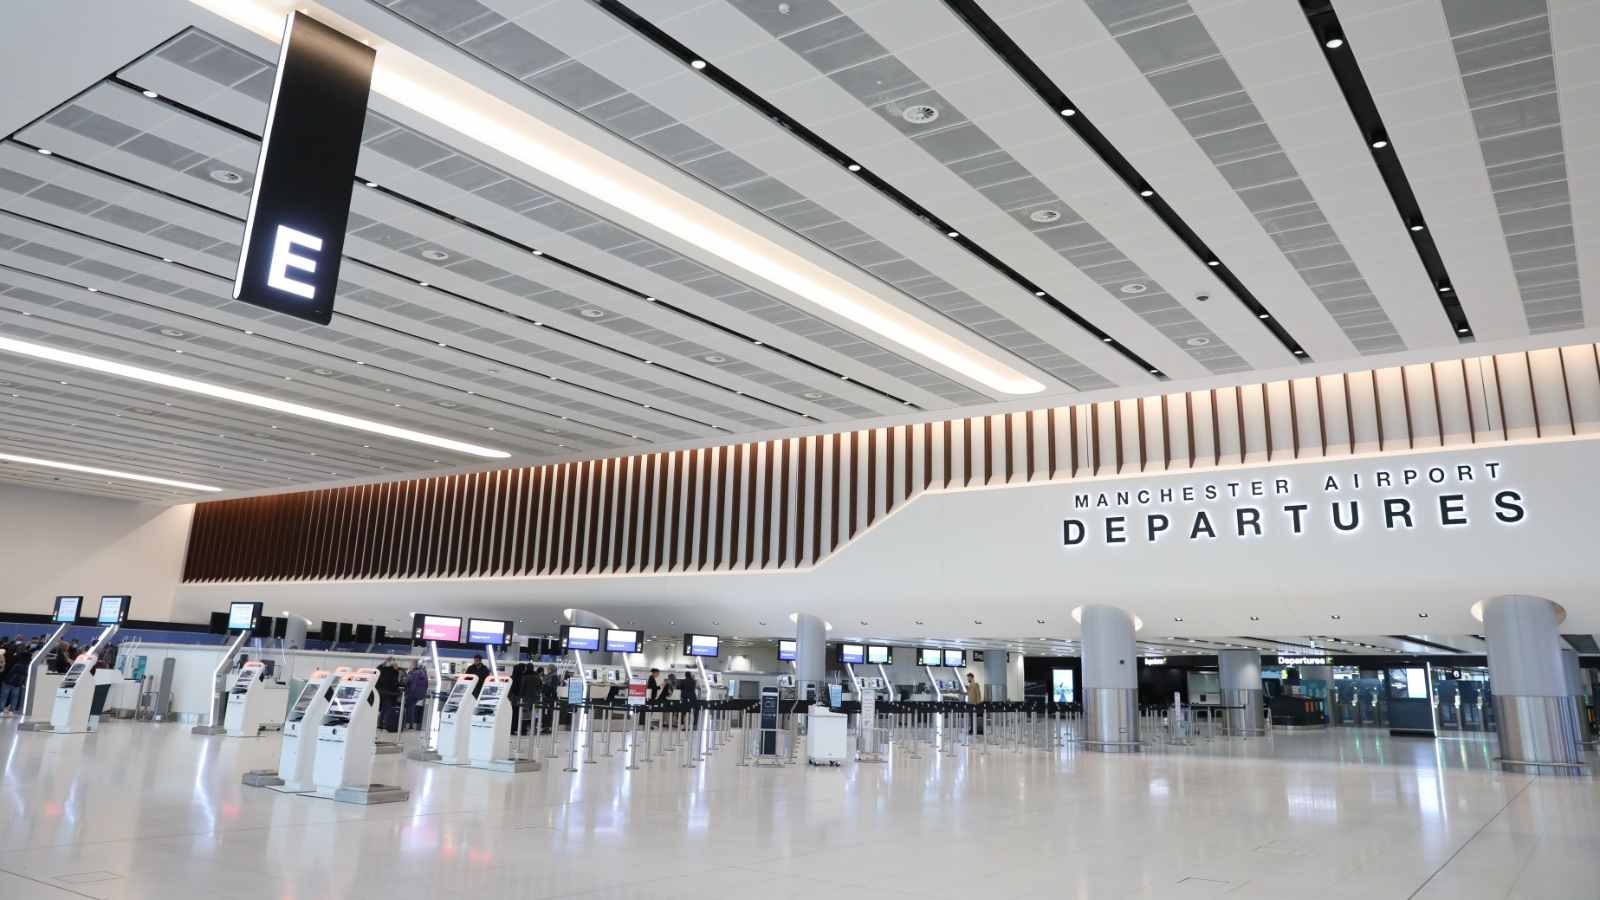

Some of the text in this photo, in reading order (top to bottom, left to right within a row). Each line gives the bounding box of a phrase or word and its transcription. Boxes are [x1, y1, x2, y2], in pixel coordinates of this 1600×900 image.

[267, 224, 323, 299] E
[1074, 462, 1500, 508] MANCHESTER AIRPORT
[1062, 489, 1526, 546] DEPARTURES
[1277, 656, 1326, 667] Departures
